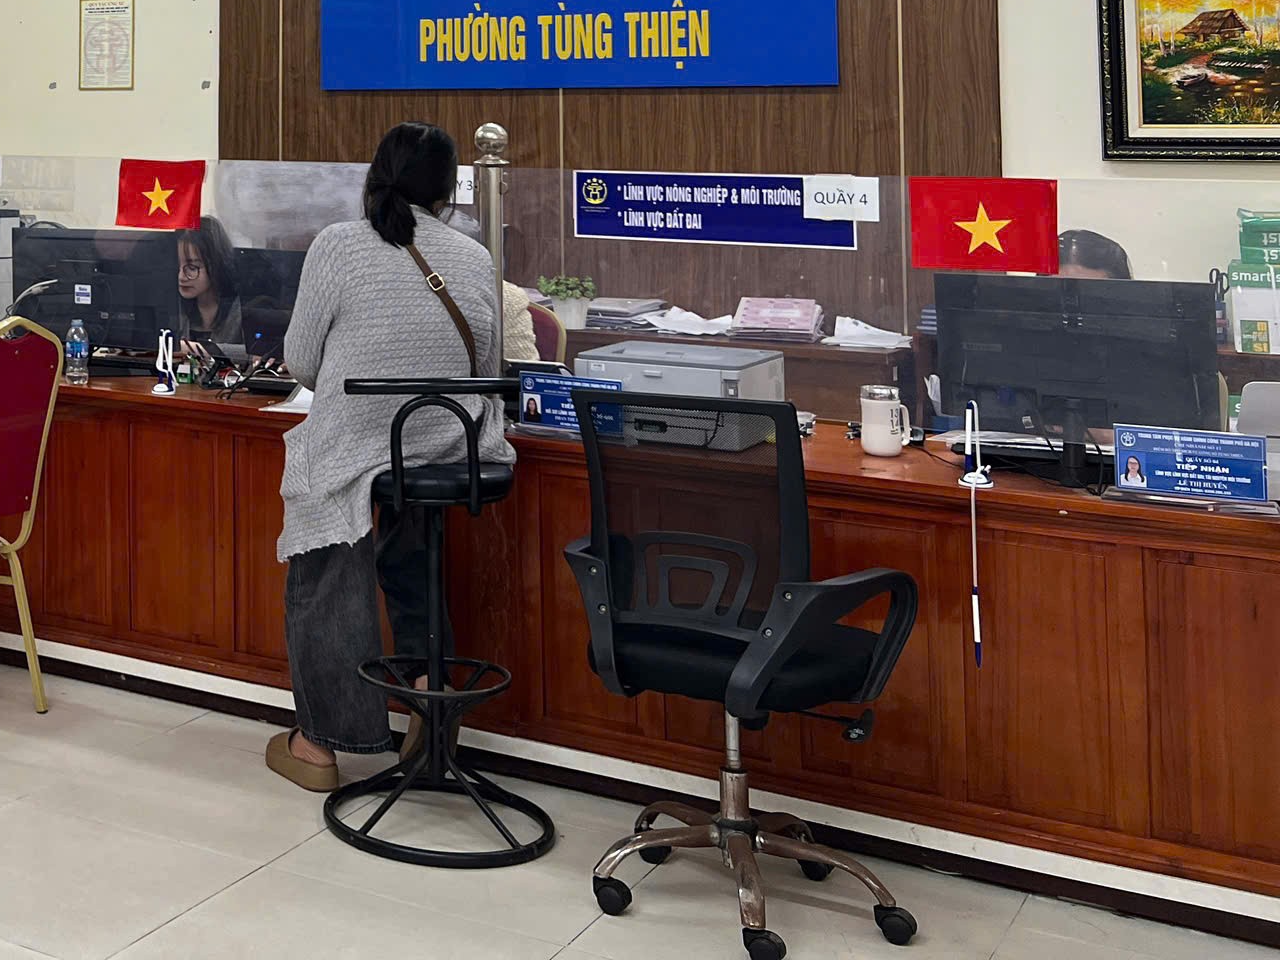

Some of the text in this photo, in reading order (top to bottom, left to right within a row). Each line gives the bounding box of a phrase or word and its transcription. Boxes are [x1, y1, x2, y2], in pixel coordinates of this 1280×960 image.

[419, 2, 526, 62] PHƯỜNG
[537, 2, 613, 61] TÙNG
[466, 180, 473, 191] 3
[623, 182, 801, 207] LĨNH VỰC NÔNG NGHIỆP & MÔI TRƯỜNG
[813, 188, 868, 205] QUẦY 4
[623, 207, 702, 231] LĨNH VỰC ĐẤT ĐAI
